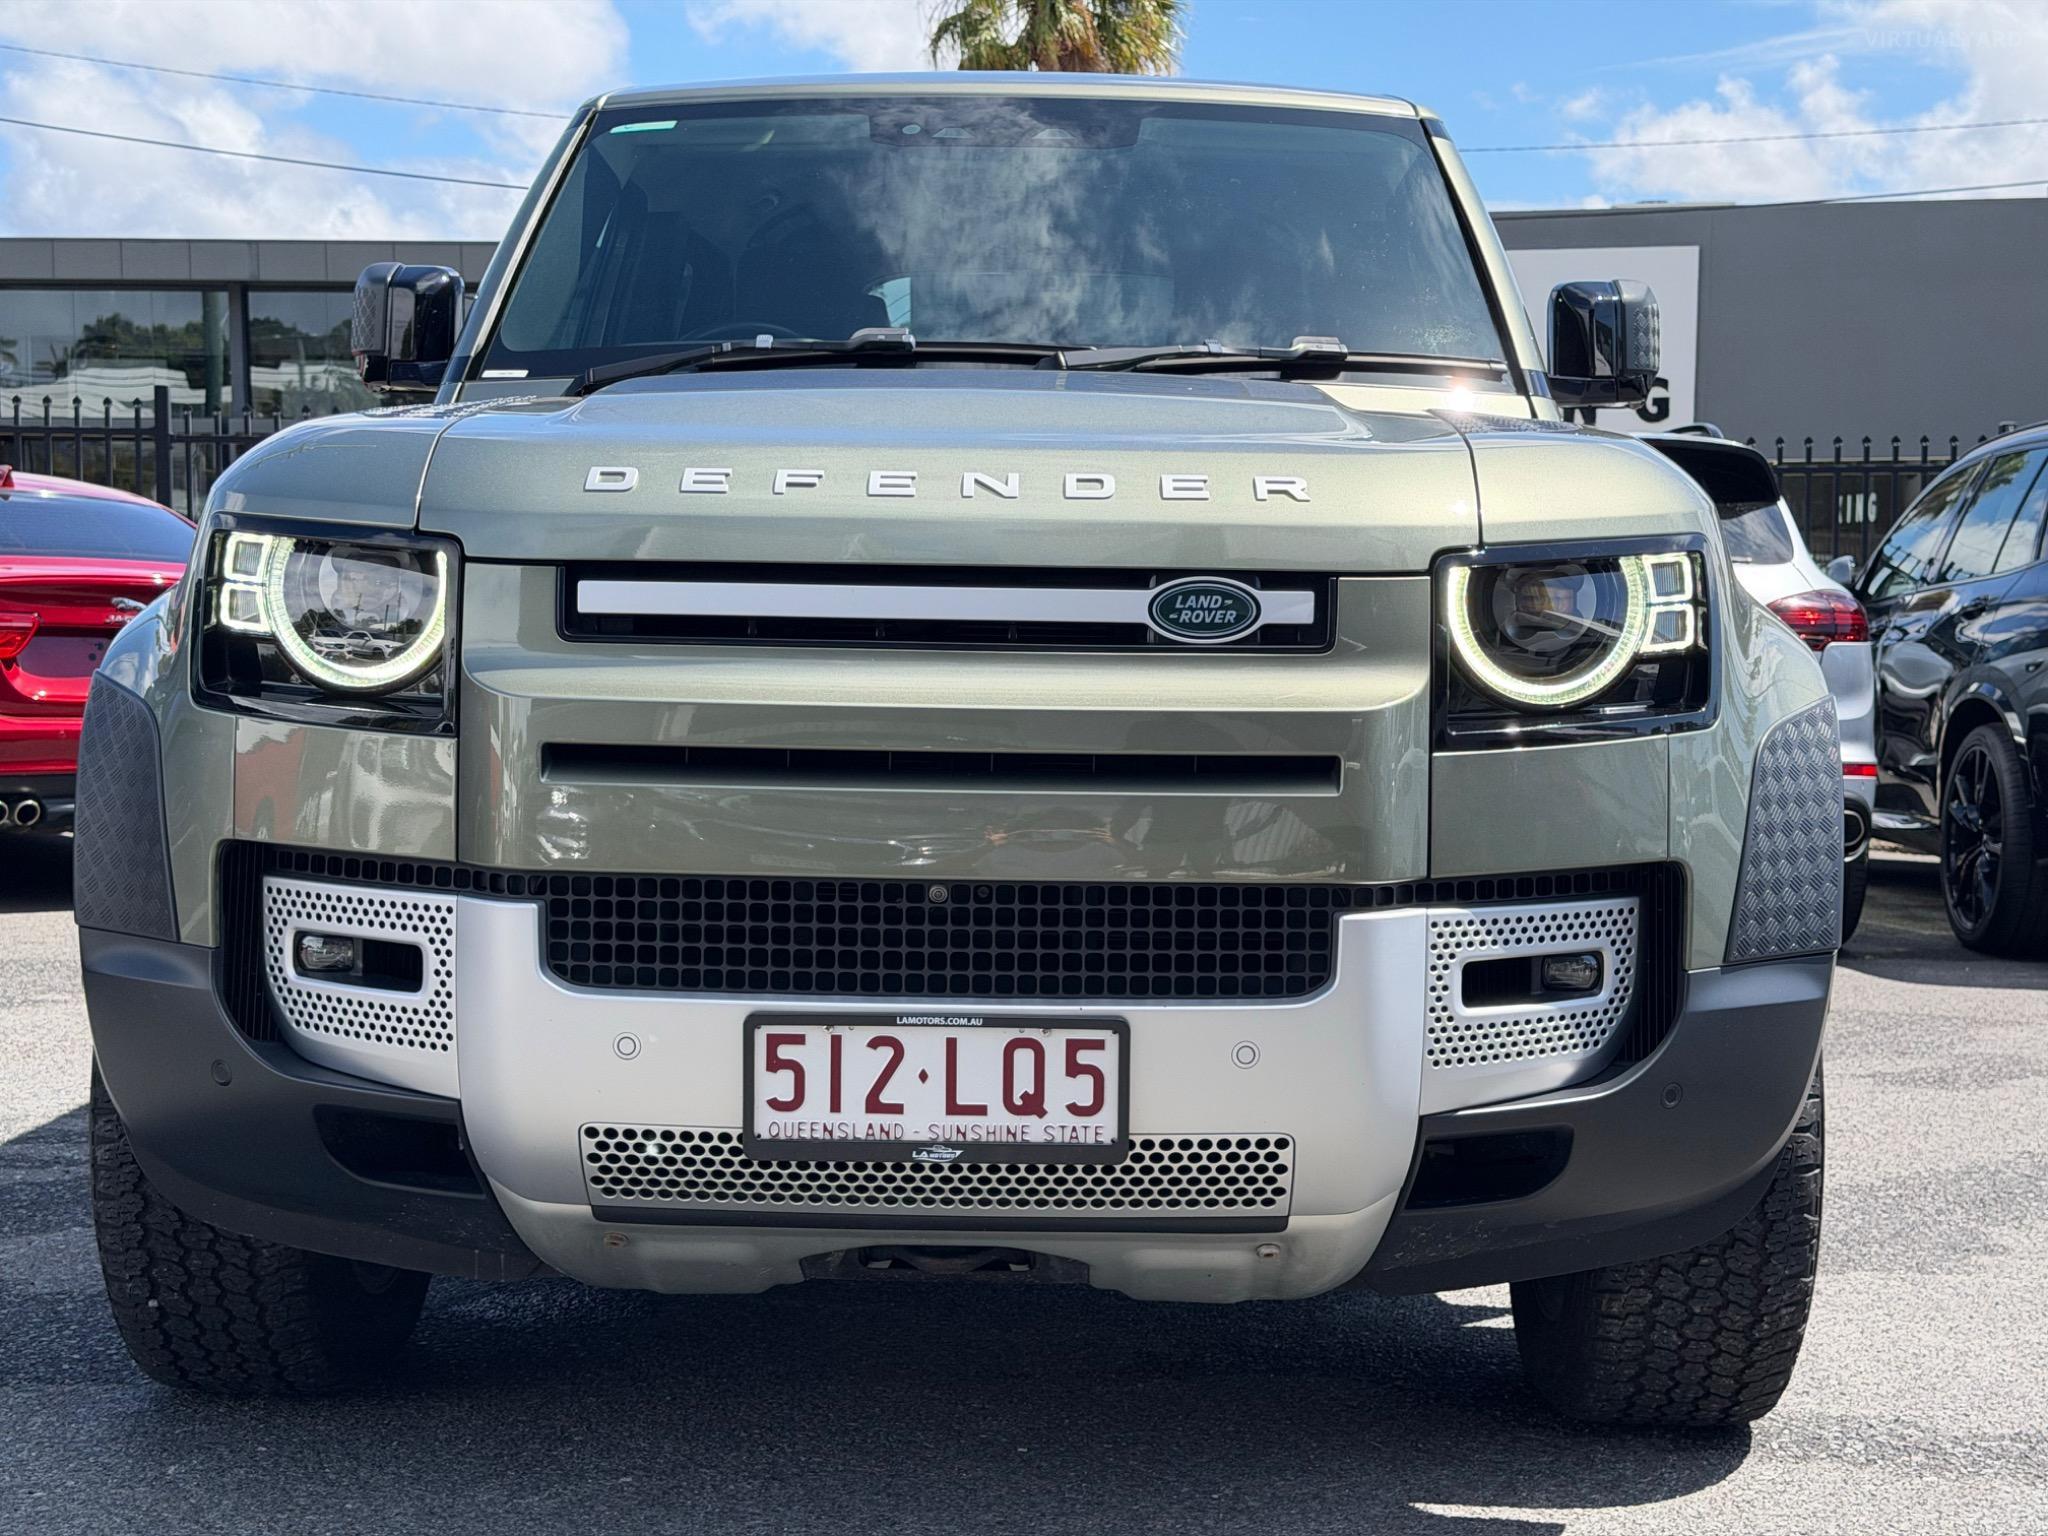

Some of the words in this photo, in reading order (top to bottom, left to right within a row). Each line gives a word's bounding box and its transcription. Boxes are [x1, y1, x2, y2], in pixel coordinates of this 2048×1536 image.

[584, 466, 1311, 501] DEFENDER
[1175, 595, 1222, 609] LAND
[1179, 610, 1237, 624] ROVER
[896, 1016, 983, 1026] LAMOTORS.COM.AU
[768, 1121, 905, 1141] QUEENSLAND
[928, 1123, 1031, 1143] SUNSHINE
[1043, 1125, 1104, 1144] STATE
